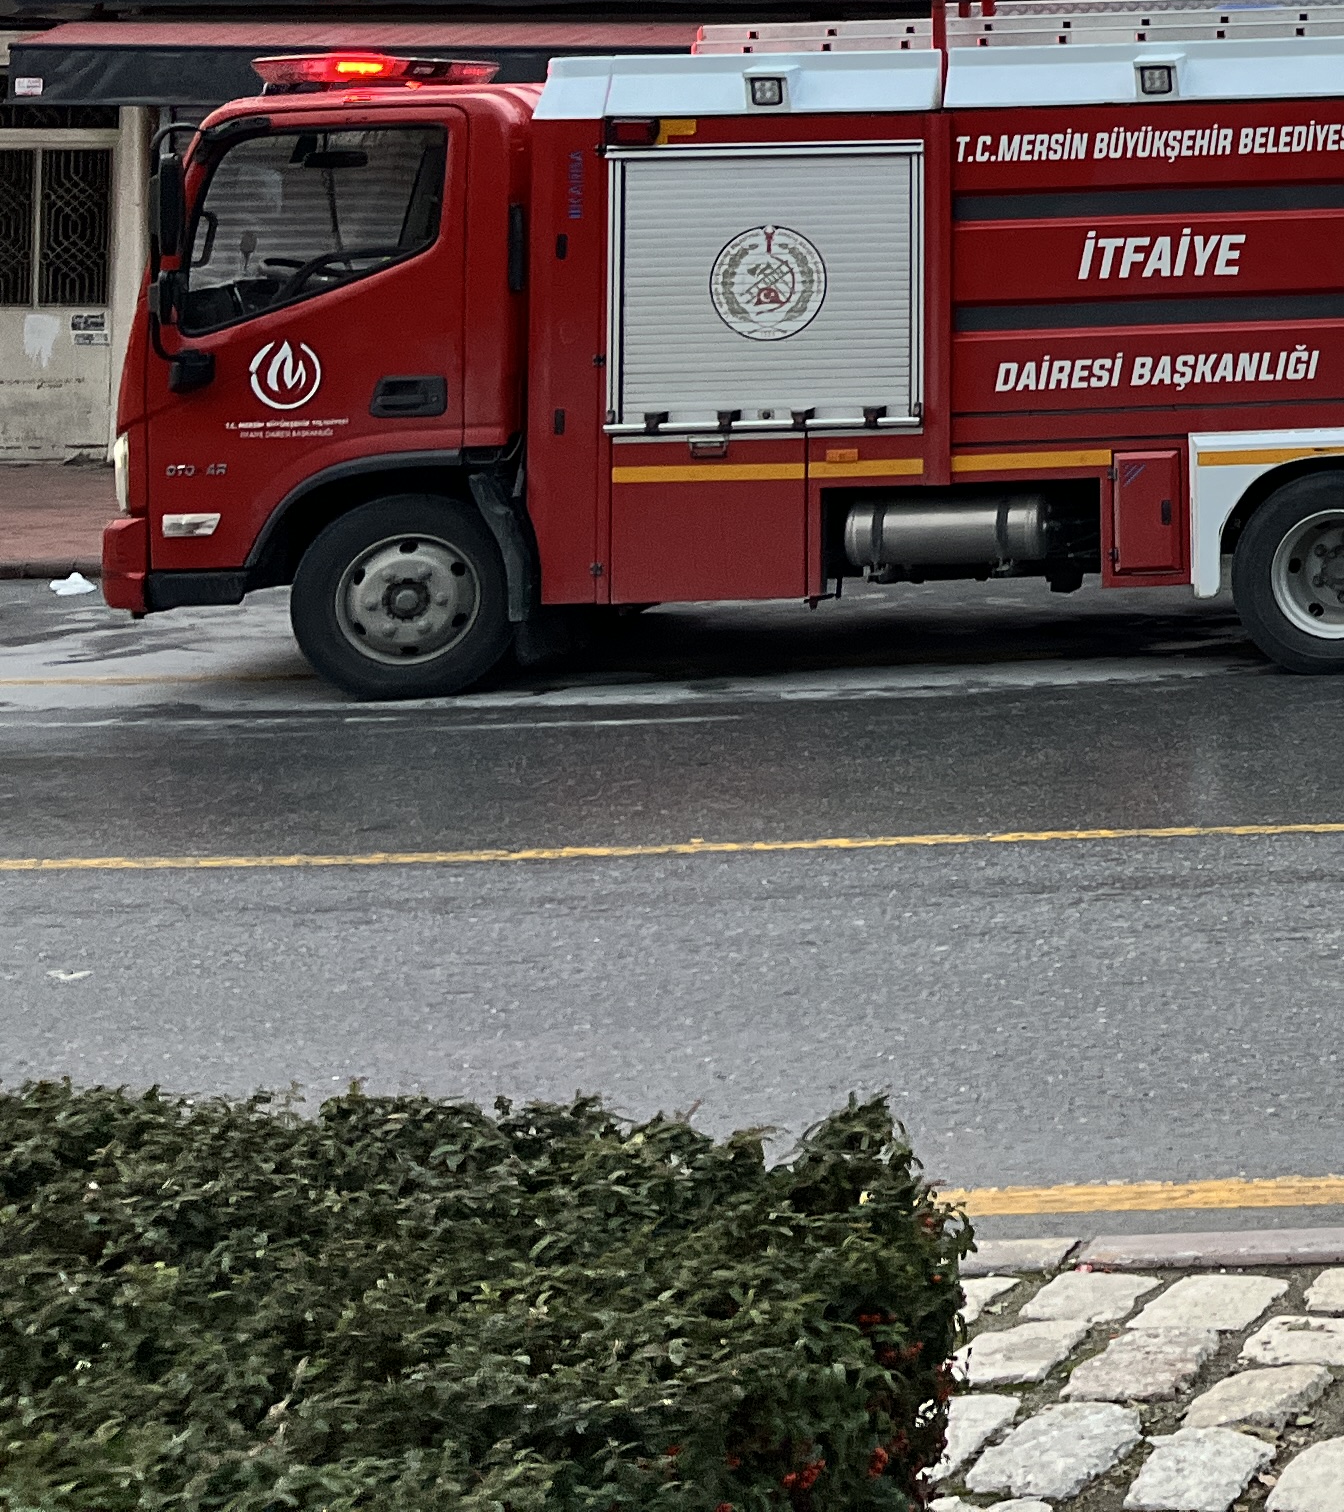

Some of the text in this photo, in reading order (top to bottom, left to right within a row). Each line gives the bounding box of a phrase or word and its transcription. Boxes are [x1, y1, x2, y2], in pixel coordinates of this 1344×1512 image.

[1093, 123, 1233, 164] BÜYÜKŞEHİR
[1077, 227, 1246, 280] İTFAİYE
[995, 344, 1320, 393] DAİRESİ BAŞKANLIĞI
